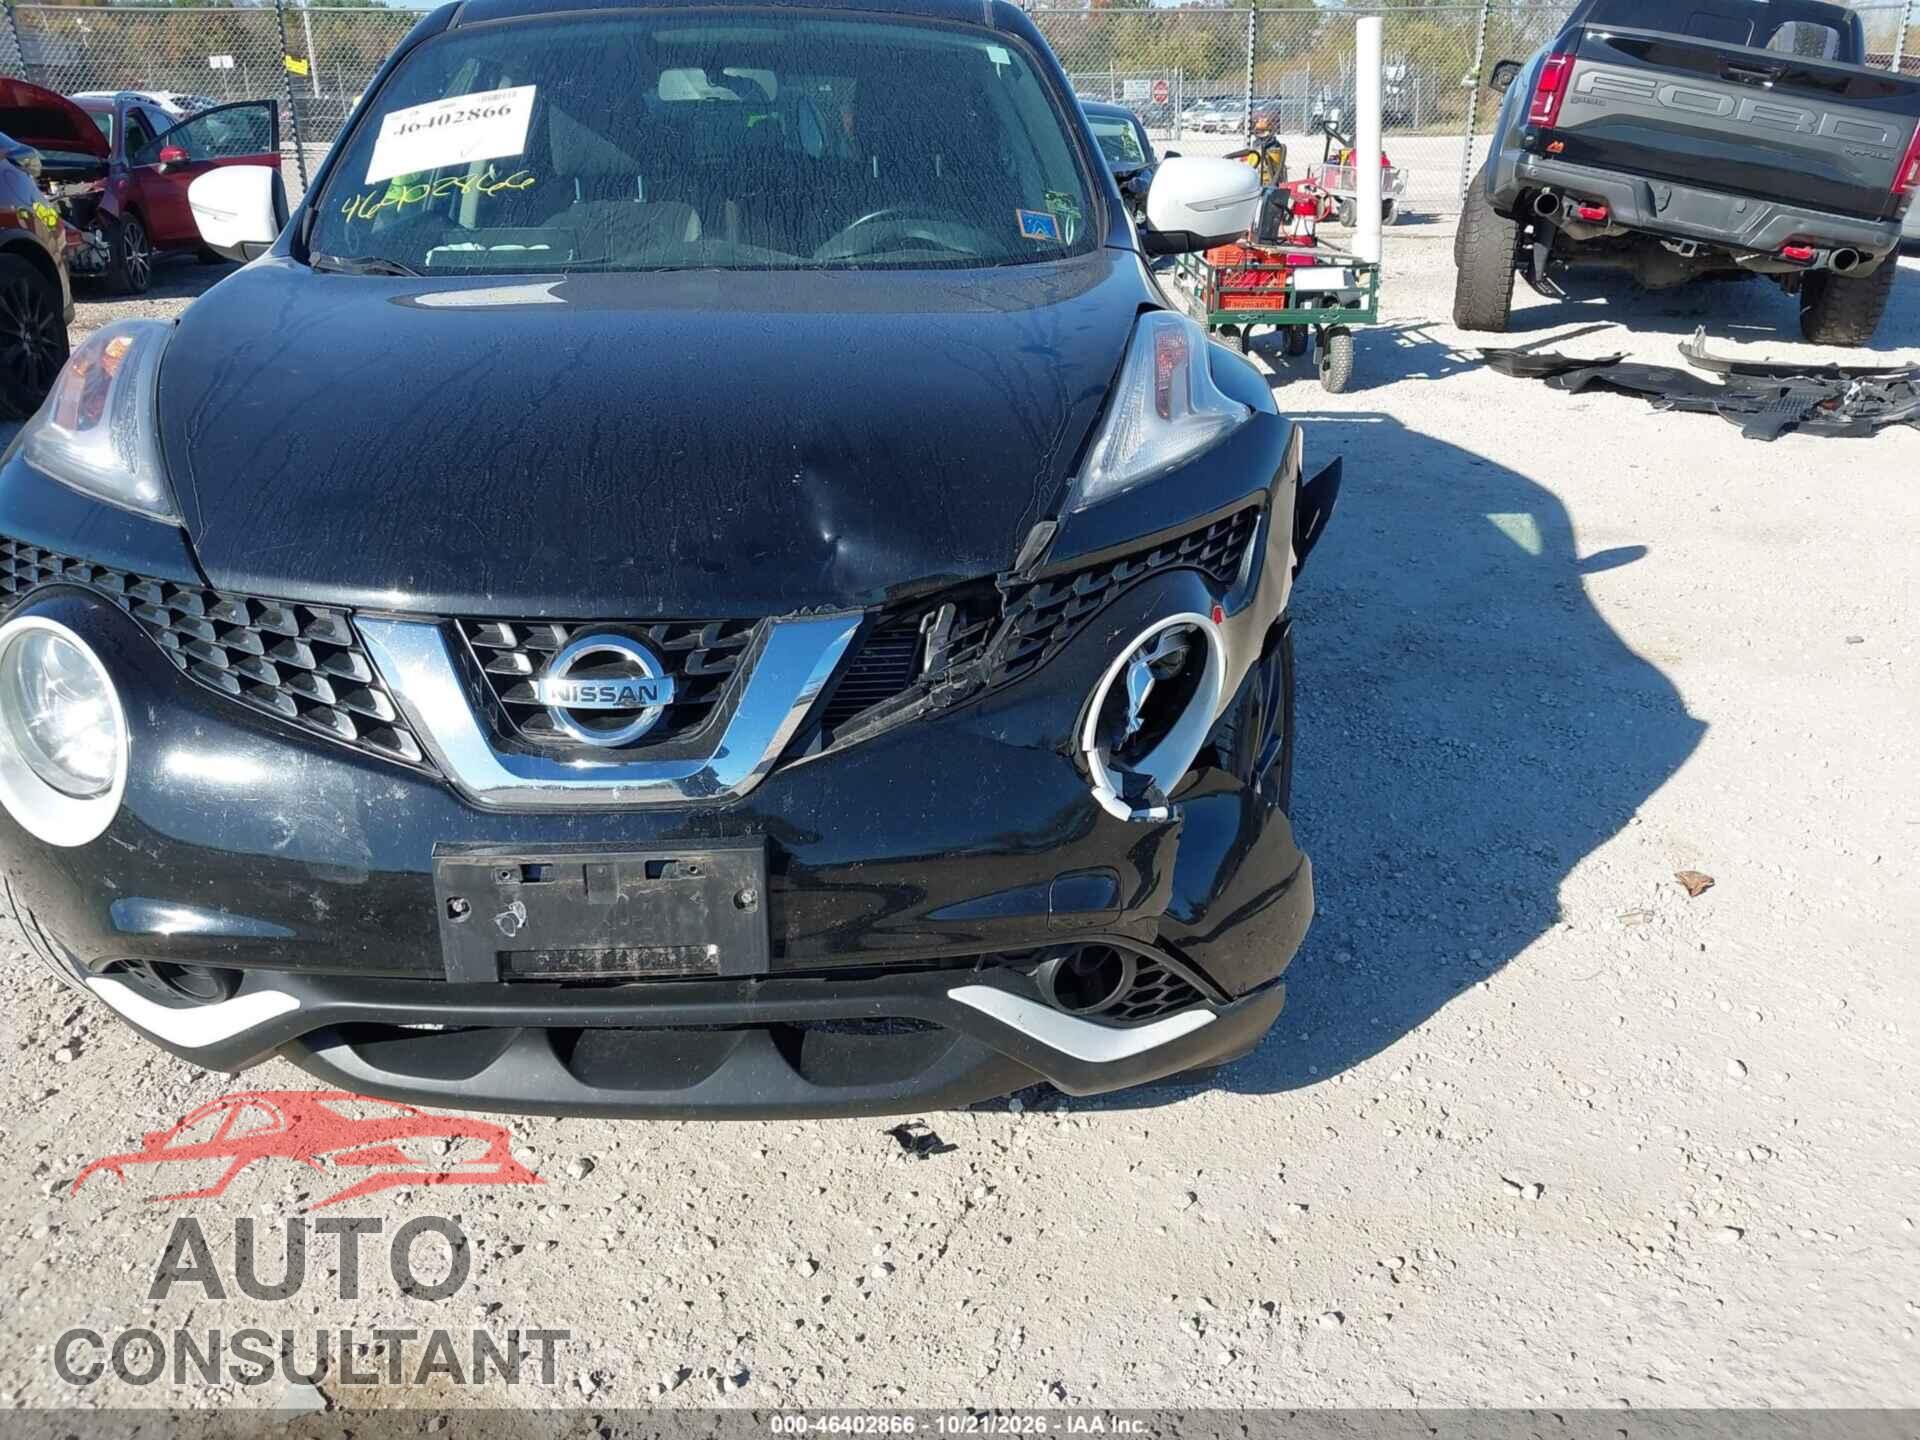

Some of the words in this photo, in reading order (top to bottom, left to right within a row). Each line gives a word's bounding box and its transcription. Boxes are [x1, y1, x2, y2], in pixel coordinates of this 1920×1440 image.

[393, 104, 512, 136] 46402866
[1573, 69, 1900, 148] FORD
[551, 685, 658, 704] NISSAN
